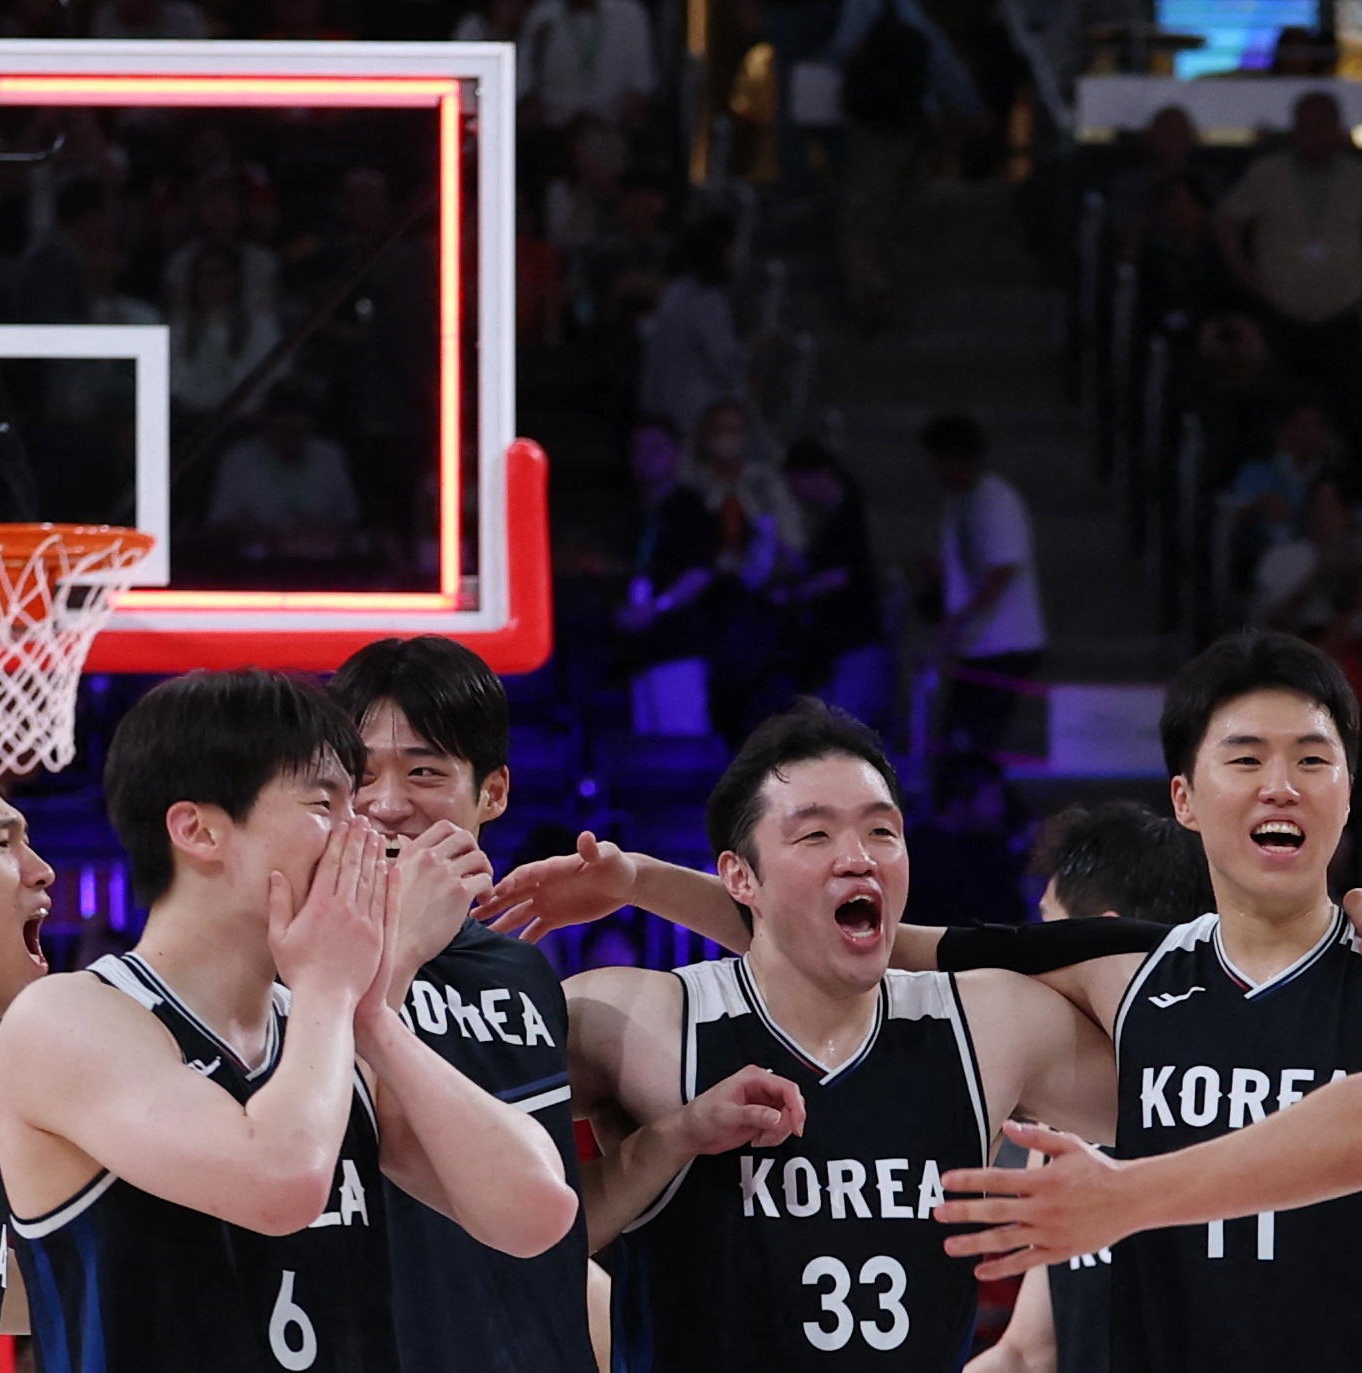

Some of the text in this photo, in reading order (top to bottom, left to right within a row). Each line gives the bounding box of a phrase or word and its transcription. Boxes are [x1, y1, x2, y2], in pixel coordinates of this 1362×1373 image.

[399, 980, 556, 1047] OREA
[1140, 1065, 1349, 1129] KORE
[739, 1155, 946, 1220] KOREA
[268, 1270, 318, 1372] 6
[801, 1255, 910, 1351] 33
